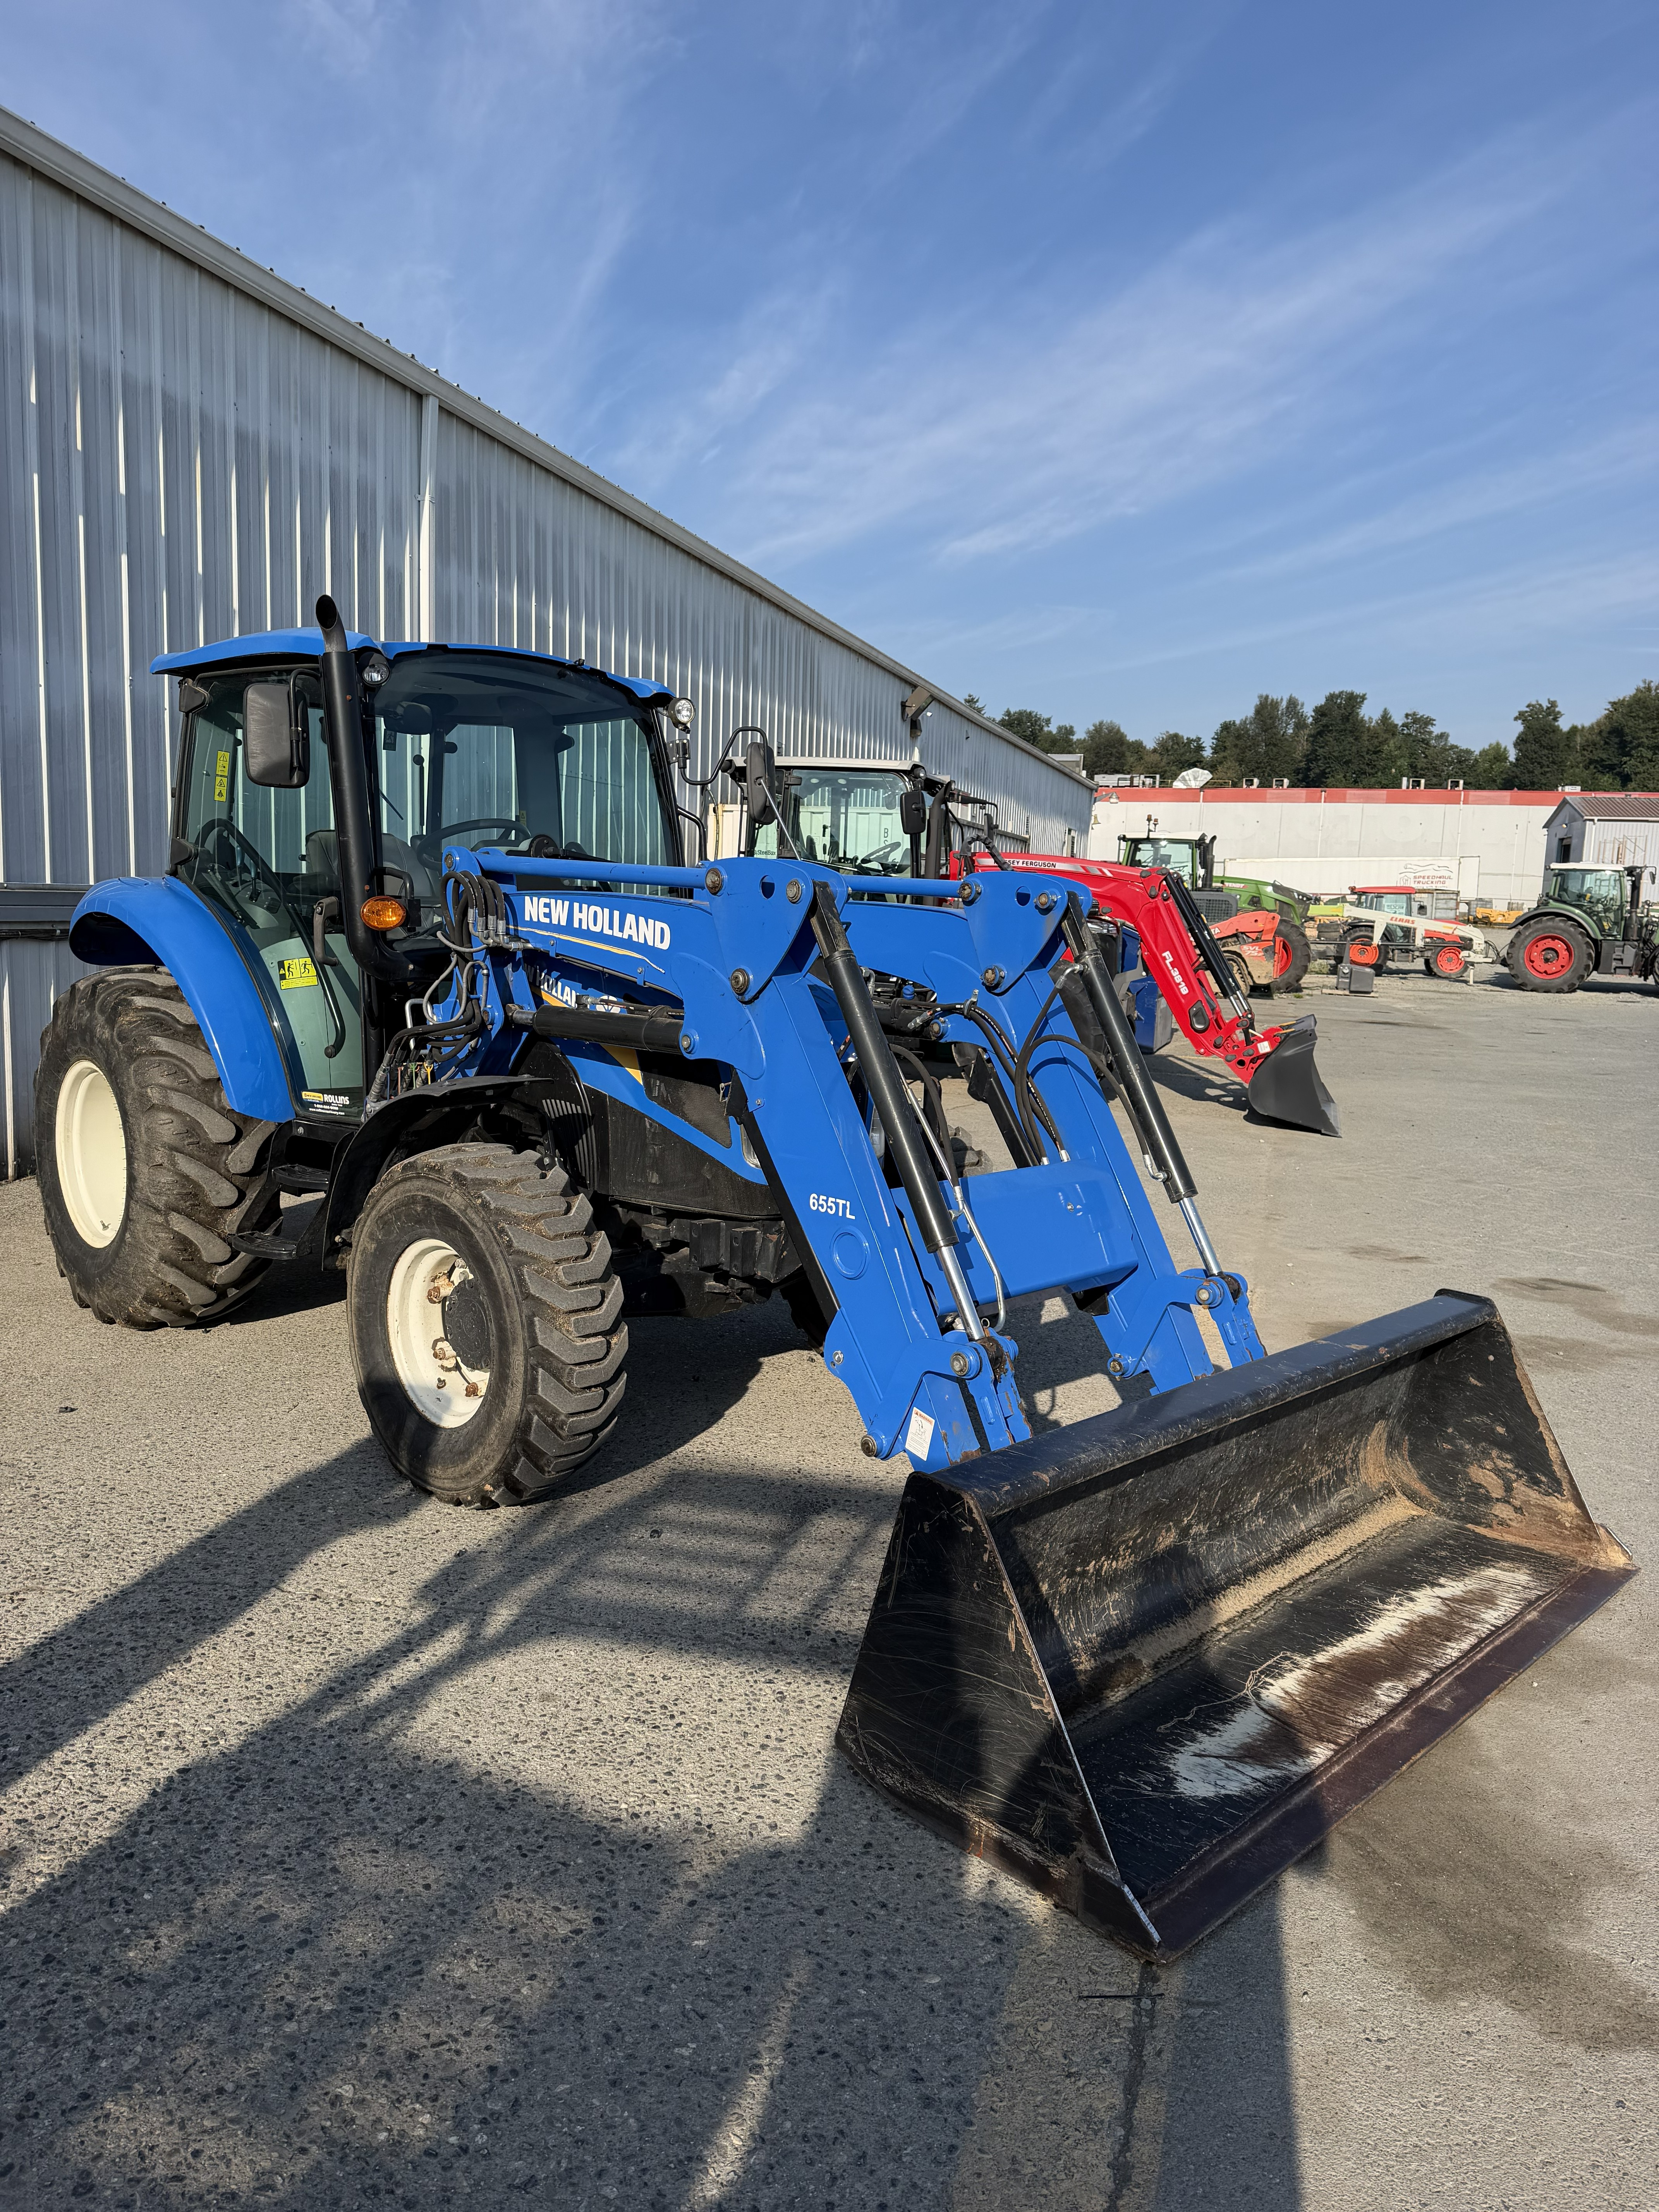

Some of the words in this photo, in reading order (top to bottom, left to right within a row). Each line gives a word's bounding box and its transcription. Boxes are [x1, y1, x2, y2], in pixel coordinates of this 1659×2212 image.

[525, 896, 569, 926] NEW
[574, 902, 671, 950] HOLLAND
[1390, 916, 1416, 925] CLAAS
[323, 1094, 350, 1104] ROLLINS
[810, 1193, 855, 1219] 655TL
